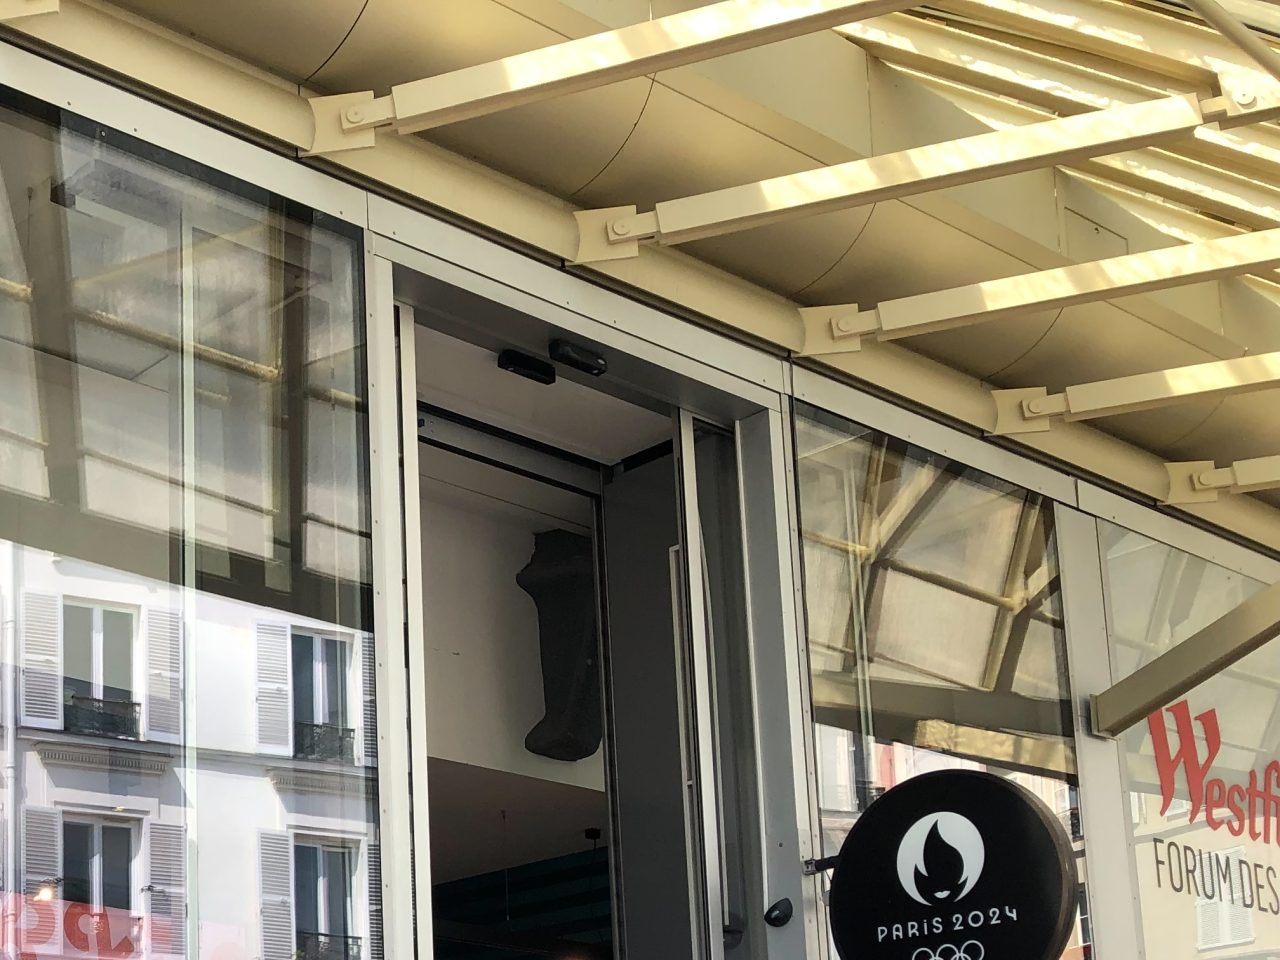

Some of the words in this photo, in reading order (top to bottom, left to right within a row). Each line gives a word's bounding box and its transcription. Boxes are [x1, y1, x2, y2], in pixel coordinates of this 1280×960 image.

[1153, 836, 1235, 905] FORUM
[1238, 858, 1280, 915] DES
[877, 916, 944, 943] PARIS
[952, 905, 1019, 932] 2024
